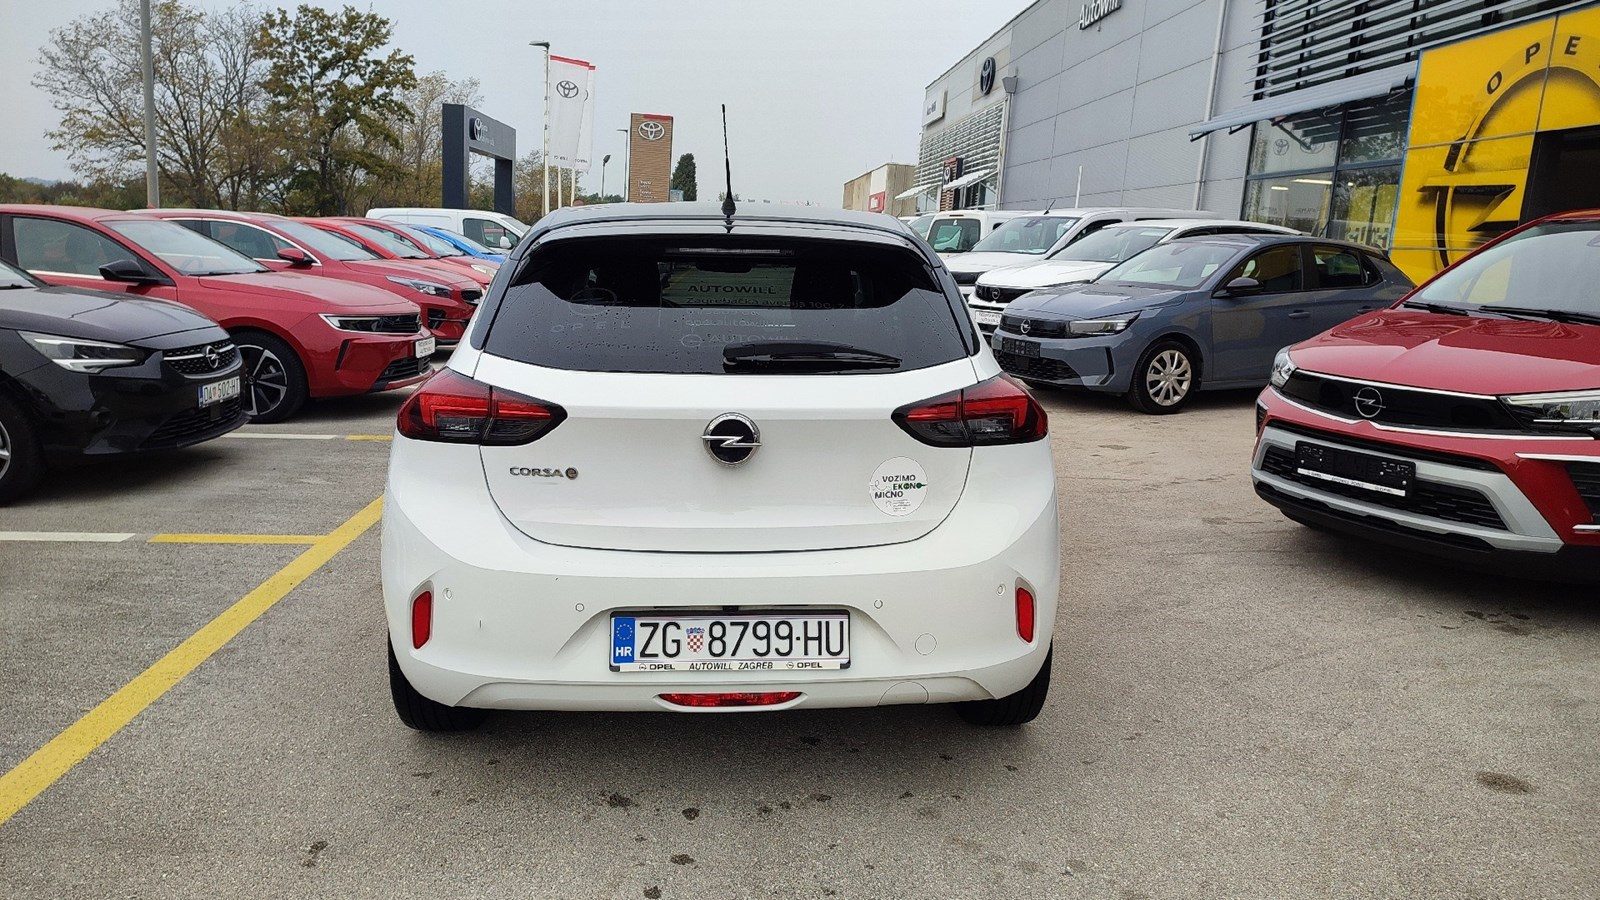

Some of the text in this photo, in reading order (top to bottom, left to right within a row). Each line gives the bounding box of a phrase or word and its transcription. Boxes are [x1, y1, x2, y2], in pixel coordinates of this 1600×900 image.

[1487, 36, 1600, 94] OPE
[687, 285, 777, 295] AUTOWILL
[509, 467, 564, 478] CORSA
[882, 474, 916, 482] VOZIMO
[874, 490, 904, 499] MICNO
[615, 646, 632, 657] HR
[639, 621, 681, 658] ZG
[649, 661, 823, 671] OPEL AUTOWILL ZAGREB OPEL
